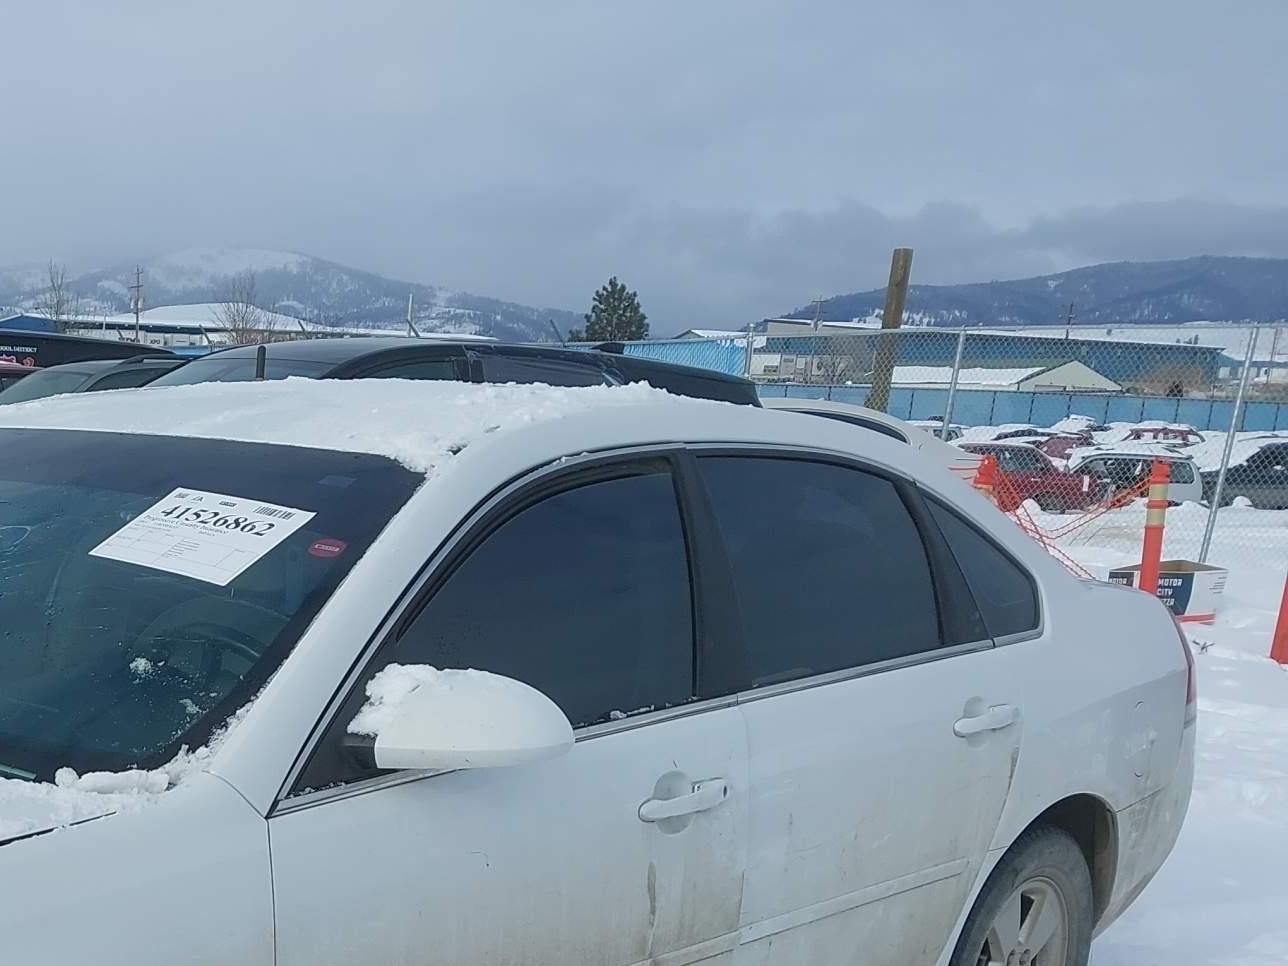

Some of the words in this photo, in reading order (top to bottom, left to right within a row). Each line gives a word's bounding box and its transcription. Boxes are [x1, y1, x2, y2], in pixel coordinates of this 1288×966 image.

[161, 504, 275, 537] 41526862
[1157, 578, 1183, 587] MOTOR
[1156, 588, 1173, 596] CITY
